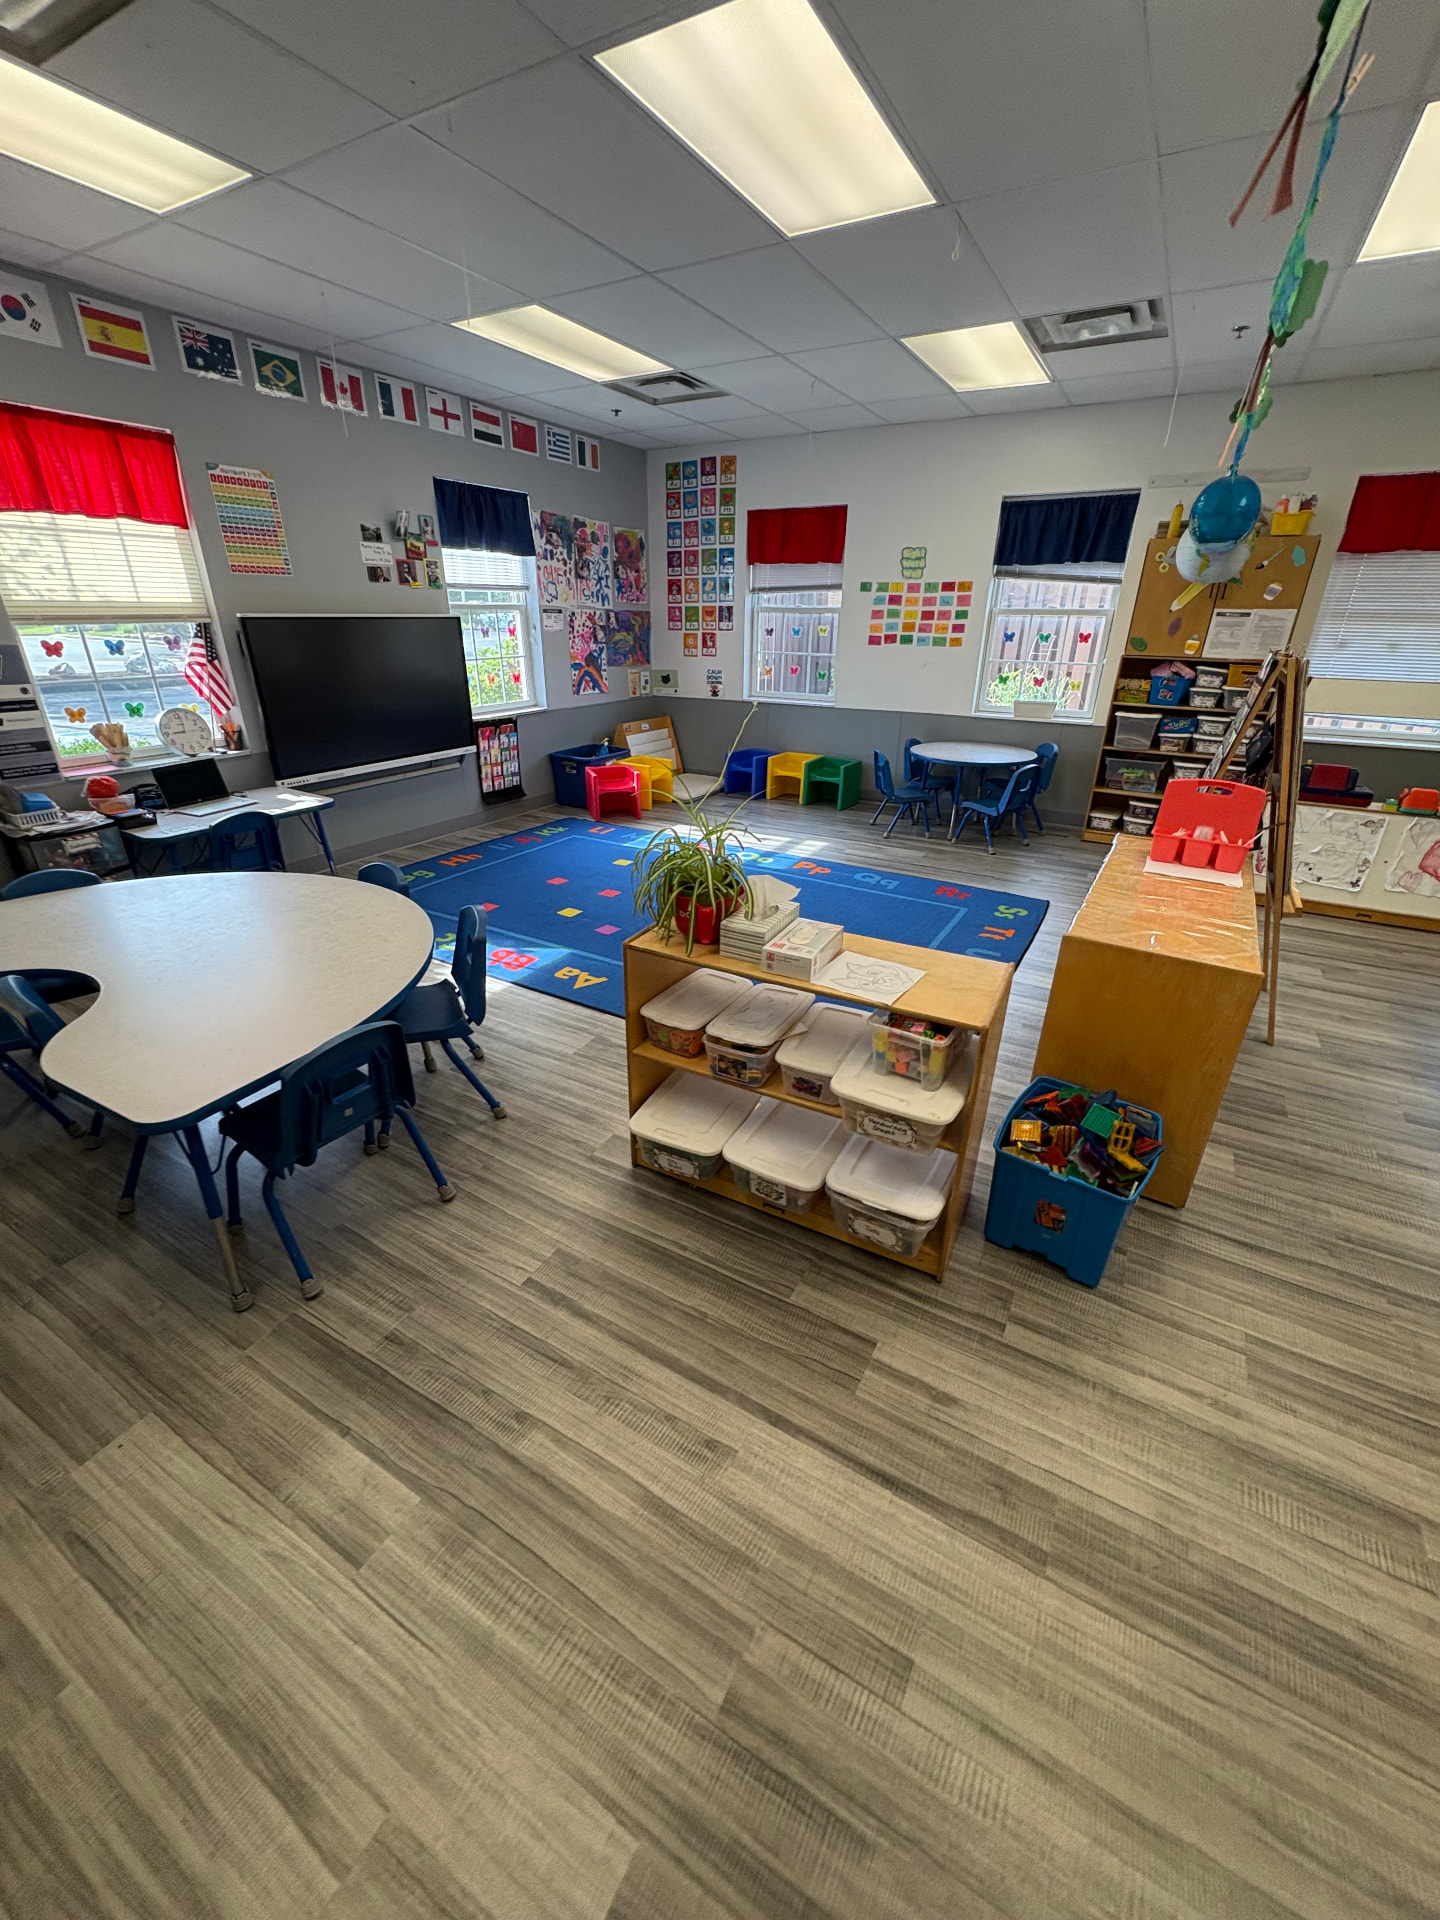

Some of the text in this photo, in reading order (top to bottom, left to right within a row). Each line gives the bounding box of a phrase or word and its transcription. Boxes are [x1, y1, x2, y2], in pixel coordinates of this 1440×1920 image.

[438, 852, 483, 867] Hh
[792, 861, 832, 875] Pp
[853, 872, 900, 890] Qq
[935, 886, 972, 899] Rr
[489, 949, 539, 971] Bb
[554, 966, 609, 990] Aa
